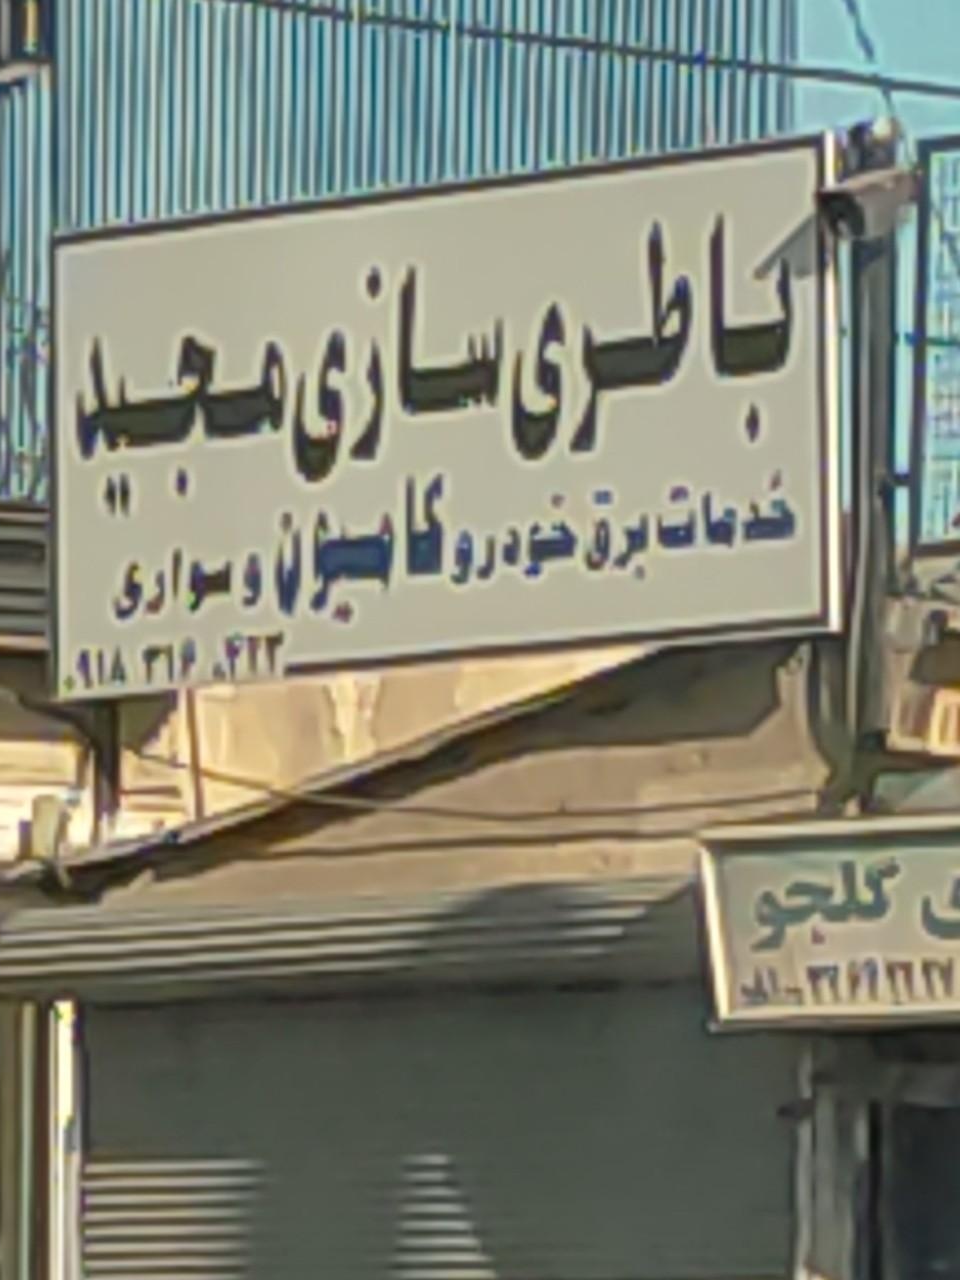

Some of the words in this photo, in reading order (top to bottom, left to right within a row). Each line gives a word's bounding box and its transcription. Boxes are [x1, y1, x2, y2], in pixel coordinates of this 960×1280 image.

[292, 265, 504, 481] سازی
[511, 211, 794, 460] باطری
[75, 331, 286, 515] مجید
[449, 493, 578, 584] خودرو
[584, 490, 649, 580] برق
[656, 471, 797, 549] خدمات
[113, 548, 232, 620] سواری
[242, 552, 263, 607] و
